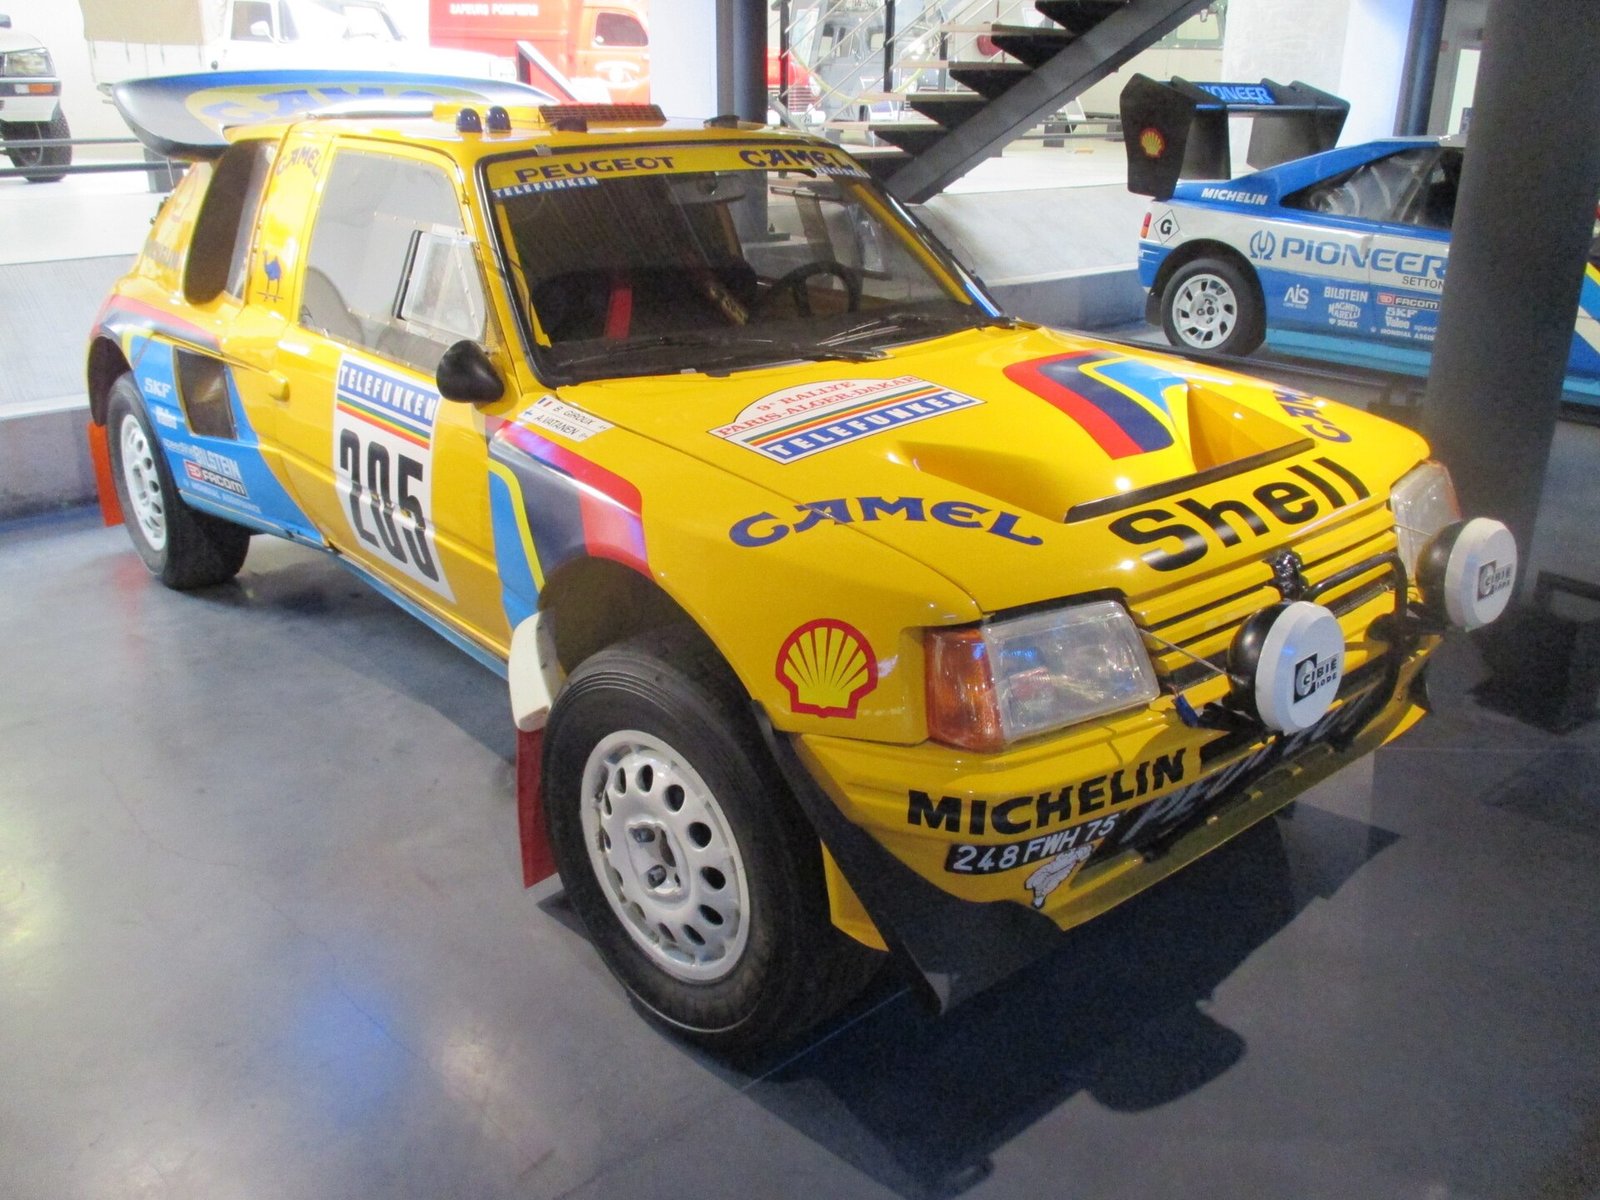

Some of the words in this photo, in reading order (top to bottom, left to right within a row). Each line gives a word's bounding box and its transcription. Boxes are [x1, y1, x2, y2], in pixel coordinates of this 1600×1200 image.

[491, 4, 539, 16] POMPIERS
[275, 145, 321, 178] CAMEL
[514, 156, 674, 183] PEUGEOT
[739, 149, 855, 170] CAMEL
[493, 176, 598, 198] TELEFUNKEN
[1201, 187, 1268, 205] MICHELIN
[1160, 219, 1172, 235] G
[1281, 236, 1448, 279] PIONEER
[1323, 286, 1369, 302] BILSTEIN
[1395, 297, 1438, 310] FACOM
[1385, 307, 1418, 318] SKF
[144, 377, 172, 398] SKF
[340, 365, 438, 422] TELEFUNKEN
[782, 381, 856, 405] RALLYE
[718, 375, 919, 437] PARIS-ALGER-DAKAR
[767, 392, 977, 457] TELEFUNKEN
[339, 428, 440, 583] 205
[1107, 456, 1371, 573] Shell
[728, 496, 1044, 548] CAMEL
[1316, 672, 1338, 689] IODE
[907, 747, 1187, 836] MICHELIN
[953, 845, 1020, 873] 248
[1021, 827, 1077, 864] FWH
[1083, 813, 1121, 840] 75
